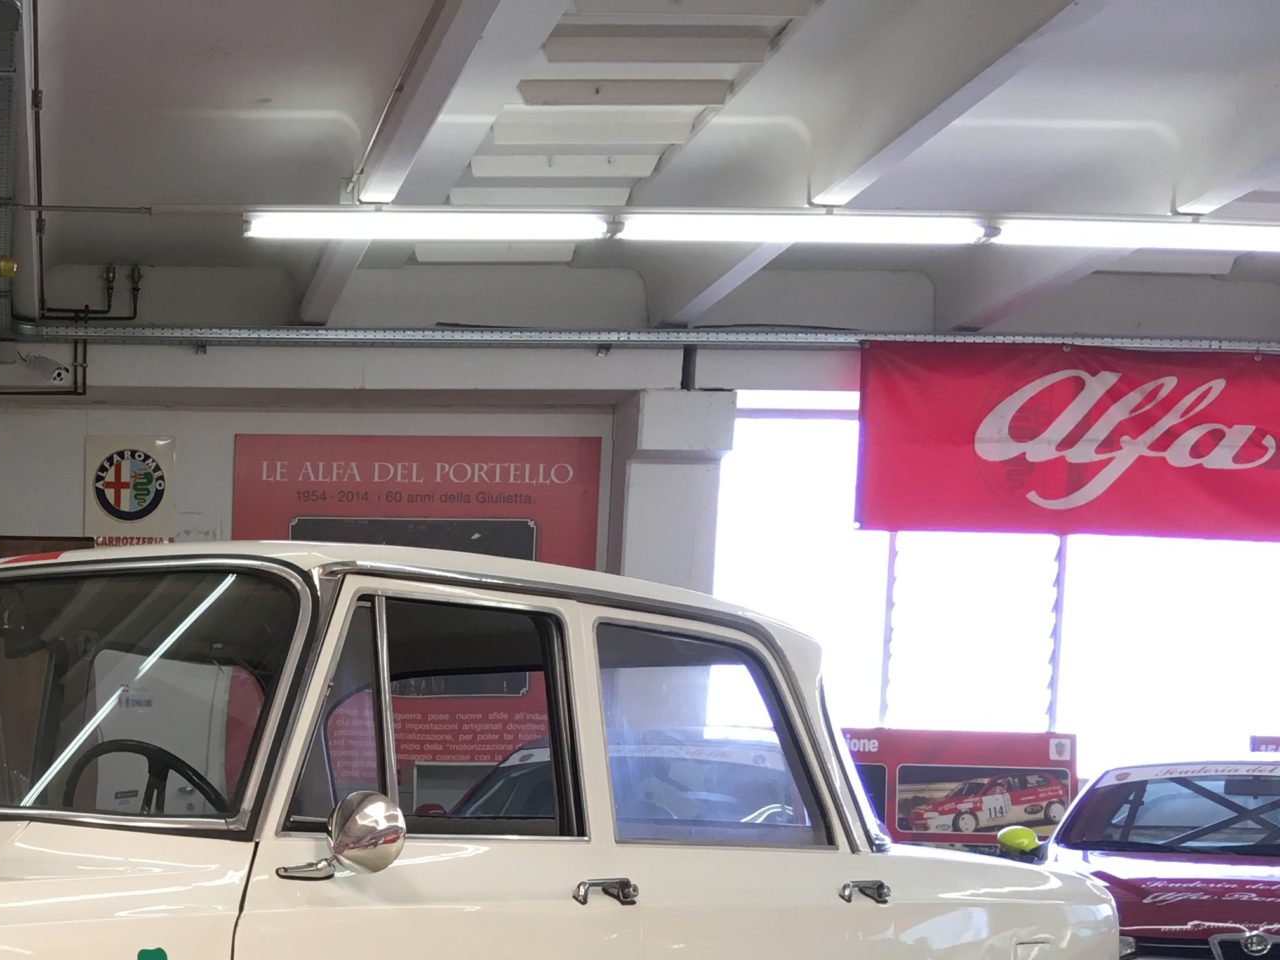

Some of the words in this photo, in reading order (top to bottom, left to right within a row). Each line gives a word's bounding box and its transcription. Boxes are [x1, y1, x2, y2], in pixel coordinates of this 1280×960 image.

[974, 368, 1277, 511] Alfa
[260, 460, 288, 482] LE
[298, 461, 361, 484] ALFA
[373, 462, 424, 484] DEL
[435, 462, 574, 487] PORTELLO
[296, 490, 327, 503] 1954
[385, 491, 403, 504] 60
[406, 492, 436, 504] anni
[439, 491, 471, 504] della
[428, 713, 450, 722] pose
[488, 712, 509, 720] sfide
[405, 723, 458, 731] impostazioni
[462, 722, 503, 731] artigianali
[506, 722, 546, 731] dovettero
[459, 734, 474, 743] per
[477, 733, 500, 742] poter
[518, 733, 542, 741] fronte
[845, 734, 879, 753] ione
[400, 743, 421, 751] inizio
[423, 743, 443, 751] della
[435, 753, 471, 761] coincise
[495, 753, 503, 761] la
[987, 806, 1004, 819] 114
